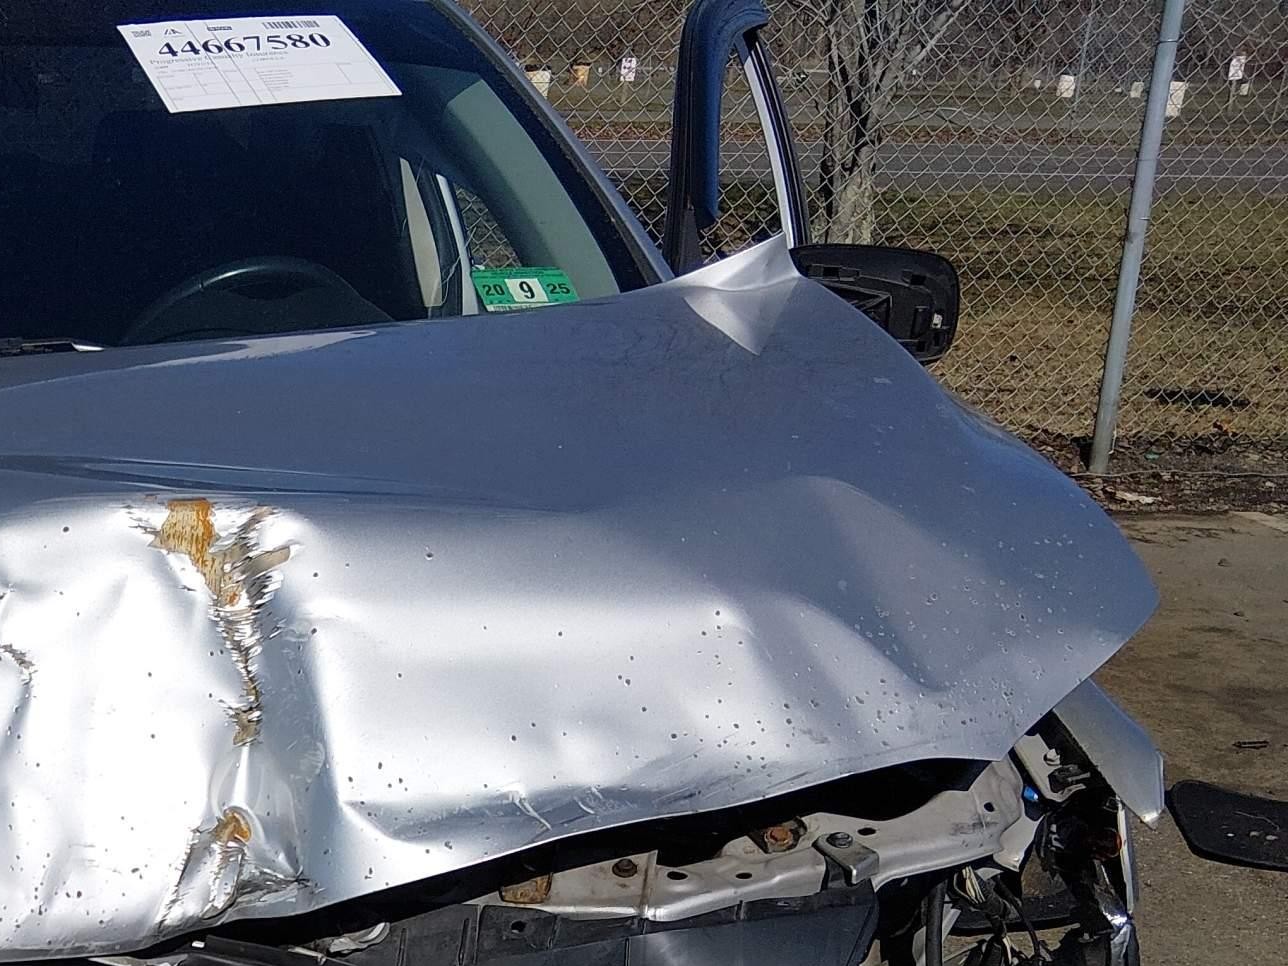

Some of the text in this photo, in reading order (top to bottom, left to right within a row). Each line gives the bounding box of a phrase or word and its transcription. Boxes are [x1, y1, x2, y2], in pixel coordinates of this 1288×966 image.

[158, 32, 331, 58] 44667580
[482, 281, 571, 300] 20 9 25
